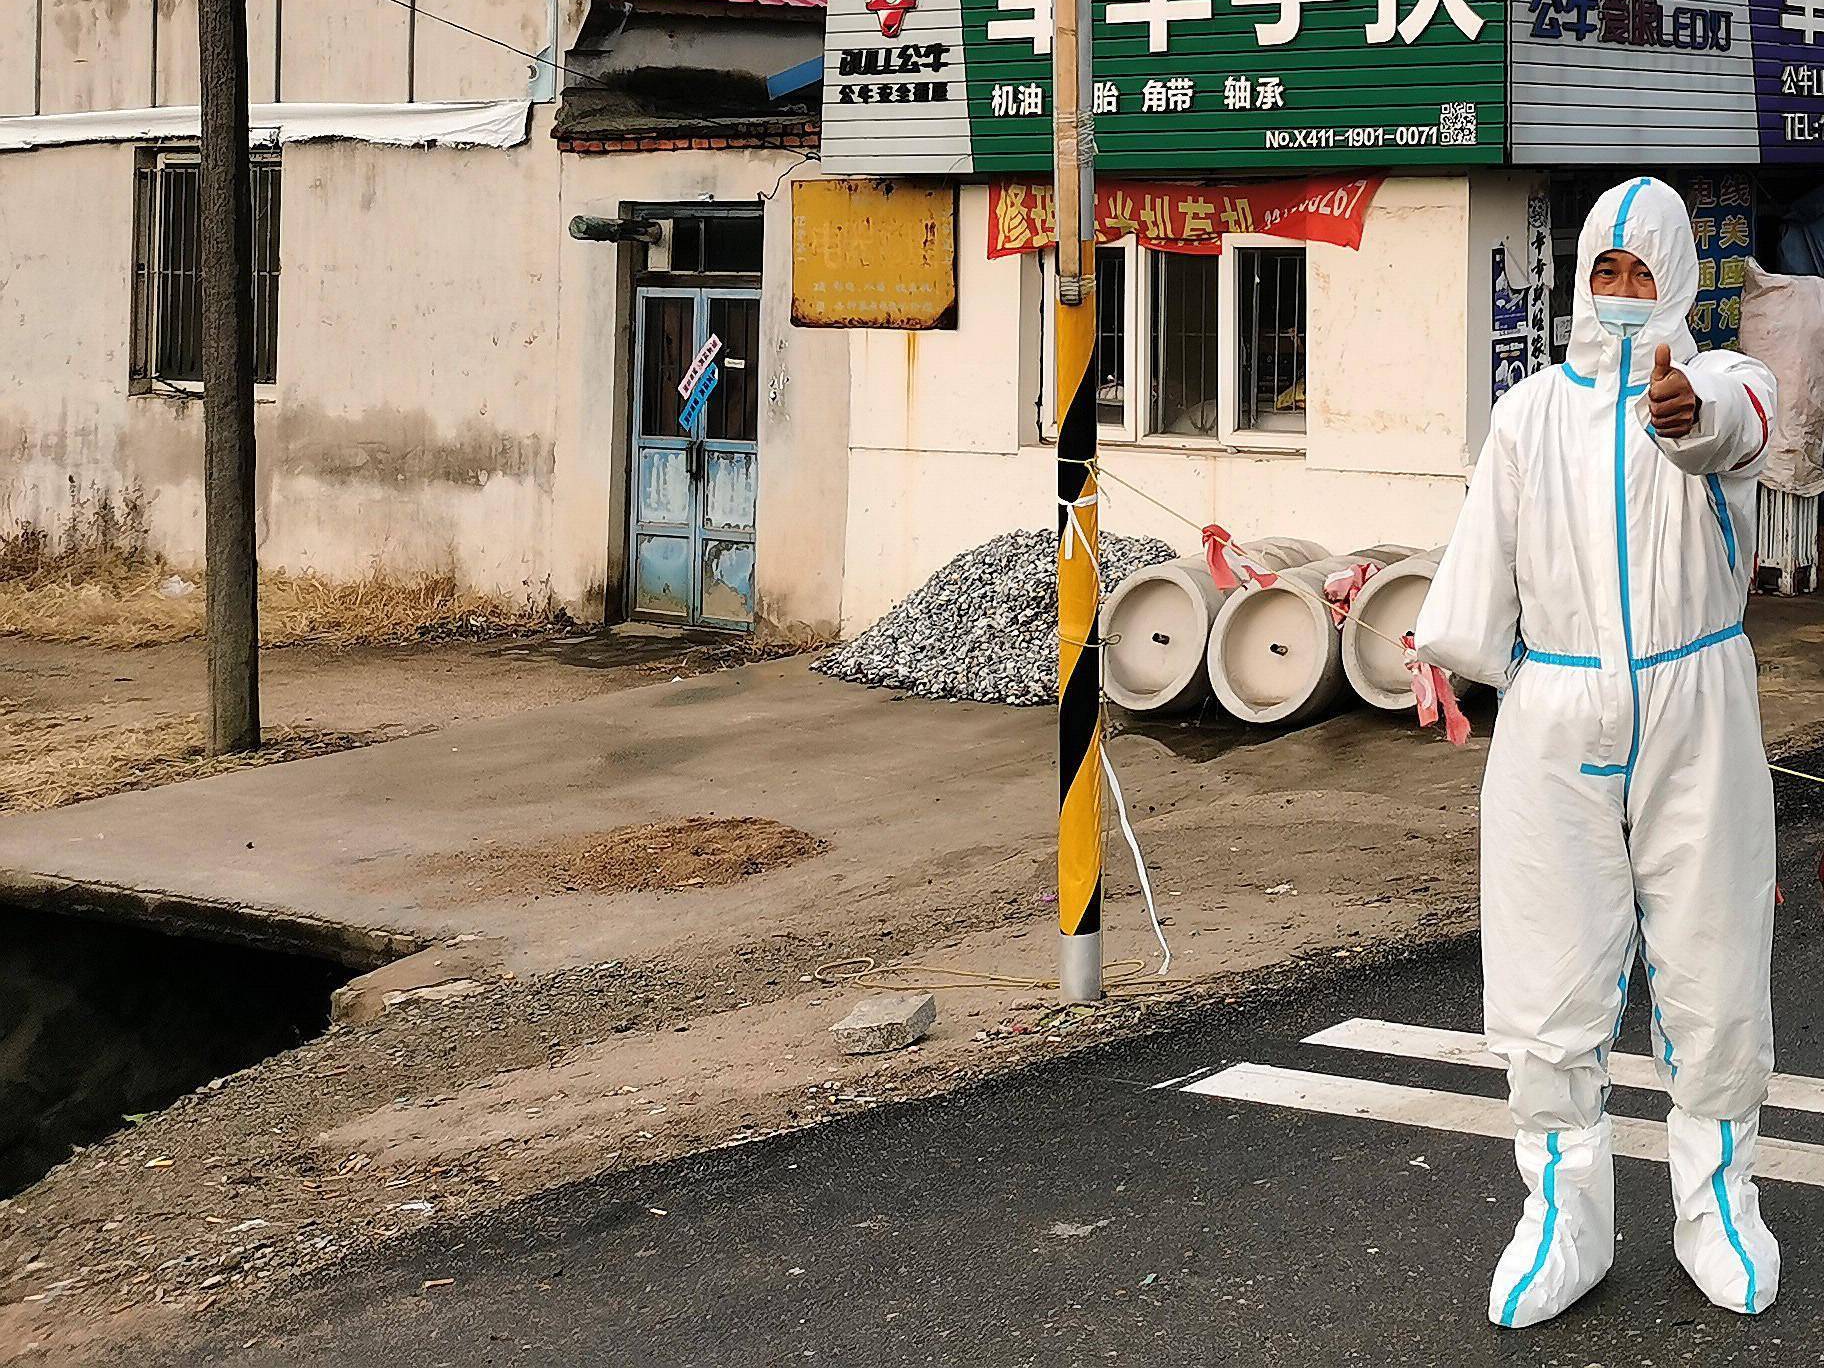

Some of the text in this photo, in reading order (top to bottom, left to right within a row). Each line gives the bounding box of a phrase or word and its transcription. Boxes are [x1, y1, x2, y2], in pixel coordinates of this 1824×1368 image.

[992, 75, 1284, 116] 机油 胎 角带 轴承
[1265, 126, 1439, 149] No.X411-1901-0071
